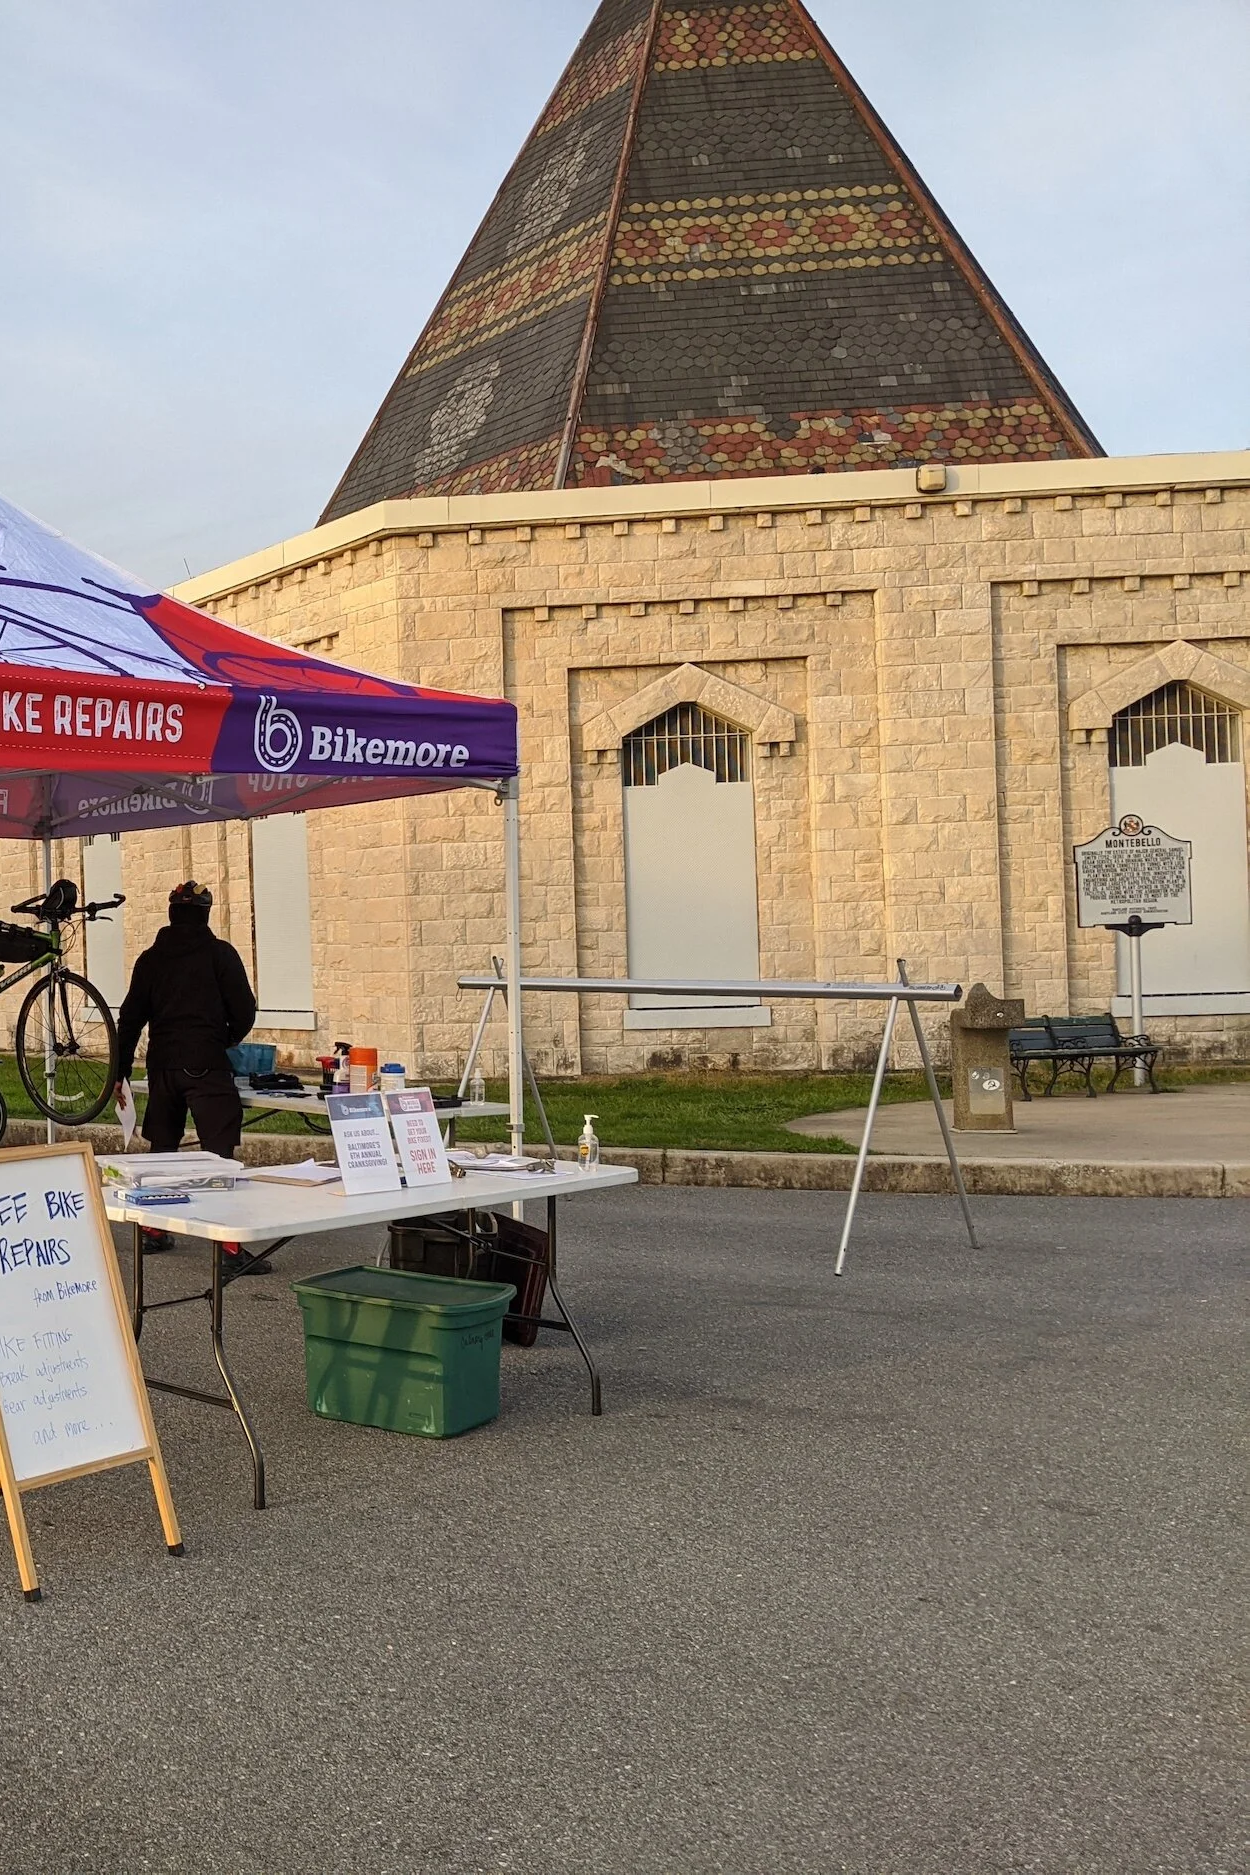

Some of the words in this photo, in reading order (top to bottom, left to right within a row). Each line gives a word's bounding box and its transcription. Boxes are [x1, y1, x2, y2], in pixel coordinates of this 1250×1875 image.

[54, 695, 184, 743] REPAIRS
[308, 726, 470, 768] Bikemore
[1105, 838, 1161, 848] MONTEBELLO
[361, 1148, 383, 1158] ANNUAL
[410, 1149, 428, 1161] SIGN
[428, 1147, 437, 1159] IN
[417, 1161, 436, 1175] HERE
[44, 1190, 85, 1219] BIKE
[32, 1328, 73, 1350] FITTING
[36, 1350, 90, 1383] adjustments
[33, 1382, 88, 1410] adjustments
[33, 1421, 58, 1445] and
